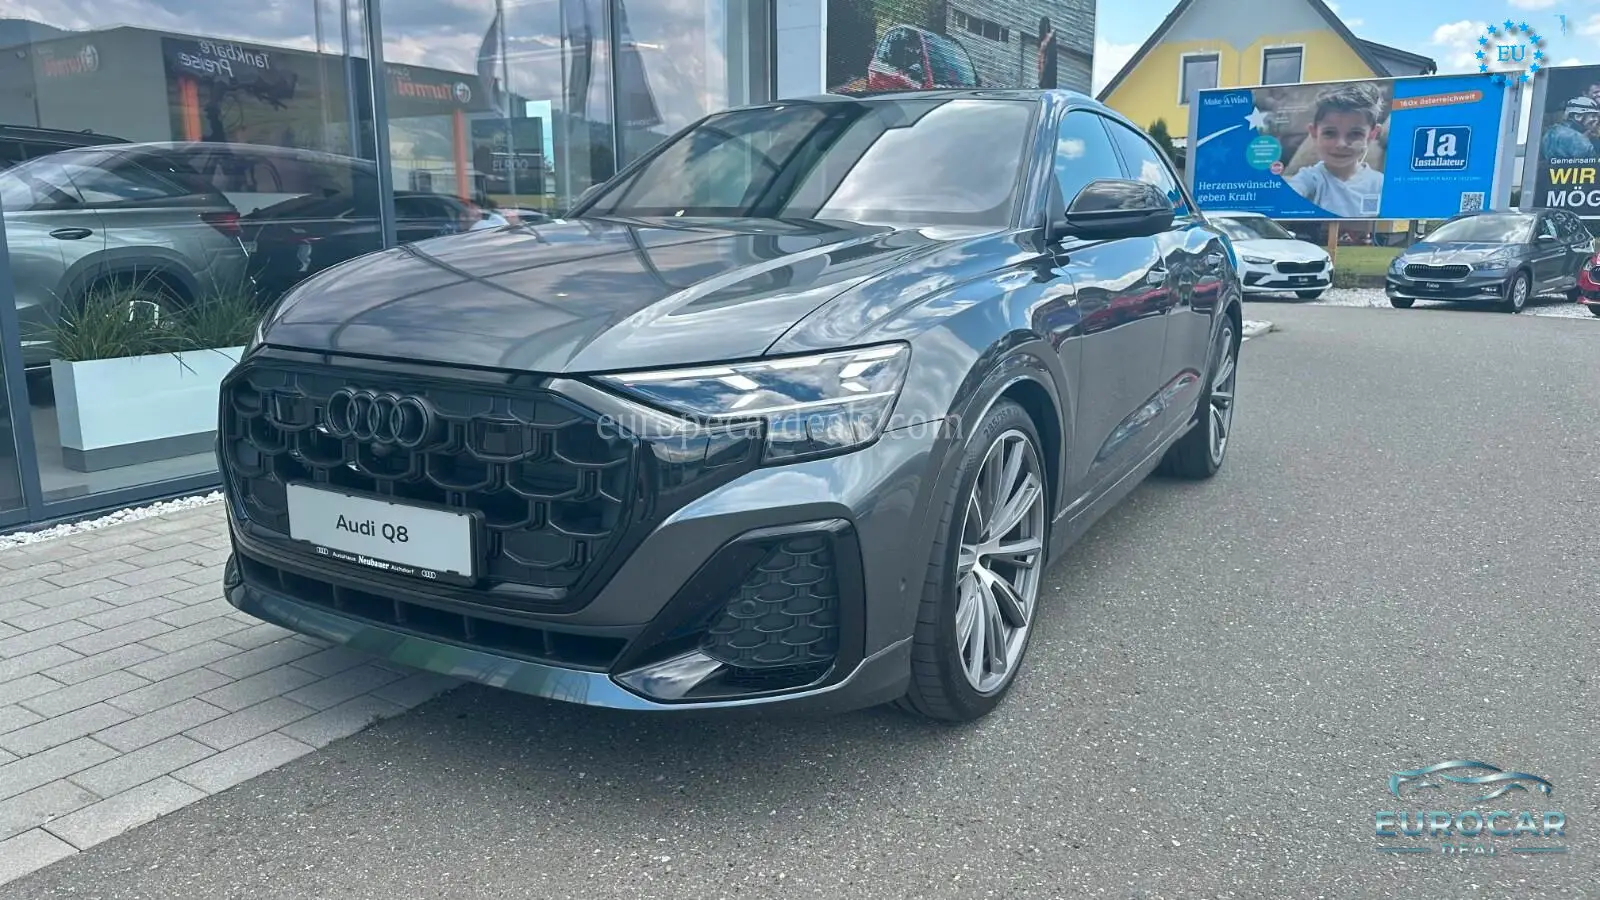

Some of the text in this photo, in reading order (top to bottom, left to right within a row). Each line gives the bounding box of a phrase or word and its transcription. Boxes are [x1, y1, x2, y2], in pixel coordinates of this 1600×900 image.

[1424, 128, 1457, 157] 1a
[1414, 157, 1465, 168] Installateur
[1550, 157, 1596, 165] Gemeinsam
[1549, 167, 1597, 185] WIR
[1198, 180, 1281, 191] Herzenswünsche
[1197, 191, 1257, 204] geben Kraft!
[1546, 186, 1600, 207] MÖG
[336, 514, 409, 543] Audi Q8
[358, 555, 389, 569] Neubauer
